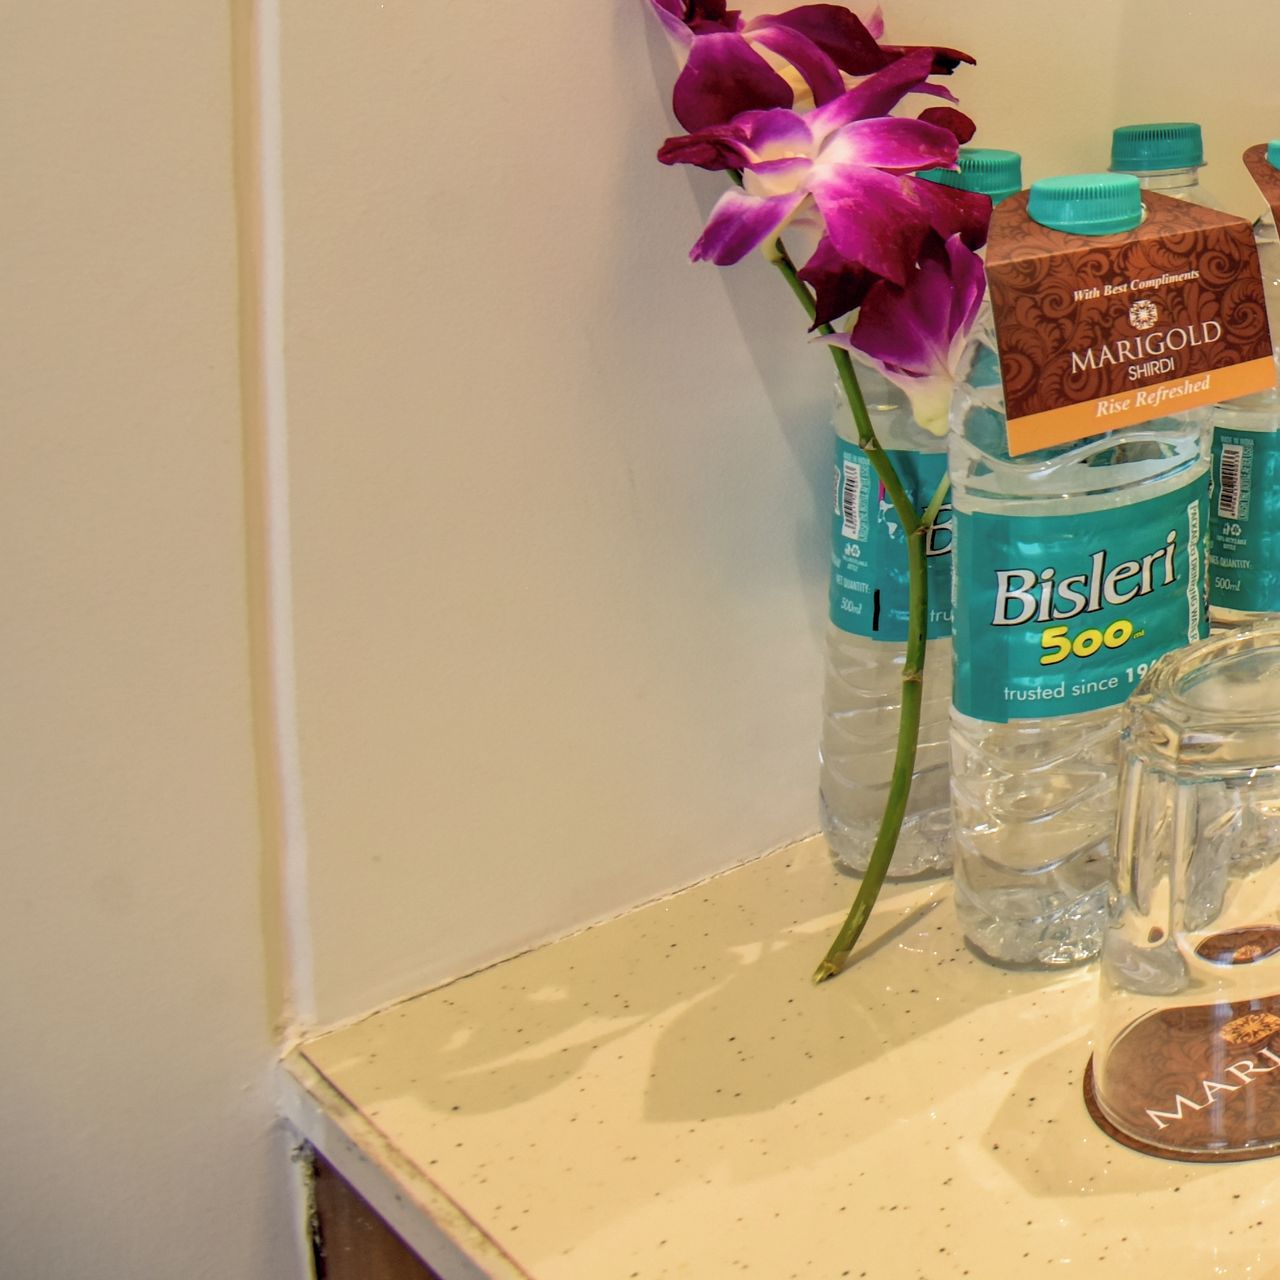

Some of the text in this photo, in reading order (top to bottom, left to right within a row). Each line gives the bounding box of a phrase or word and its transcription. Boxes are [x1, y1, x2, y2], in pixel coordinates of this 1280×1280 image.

[1073, 269, 1200, 302] With Best Compliments
[1072, 321, 1222, 374] MARIGOLD
[1128, 357, 1175, 381] SHIRDI
[1096, 375, 1211, 418] Rise Refreshed
[991, 529, 1178, 626] Bisleri
[1039, 619, 1133, 665] 500
[1004, 660, 1156, 701] trusted since 19
